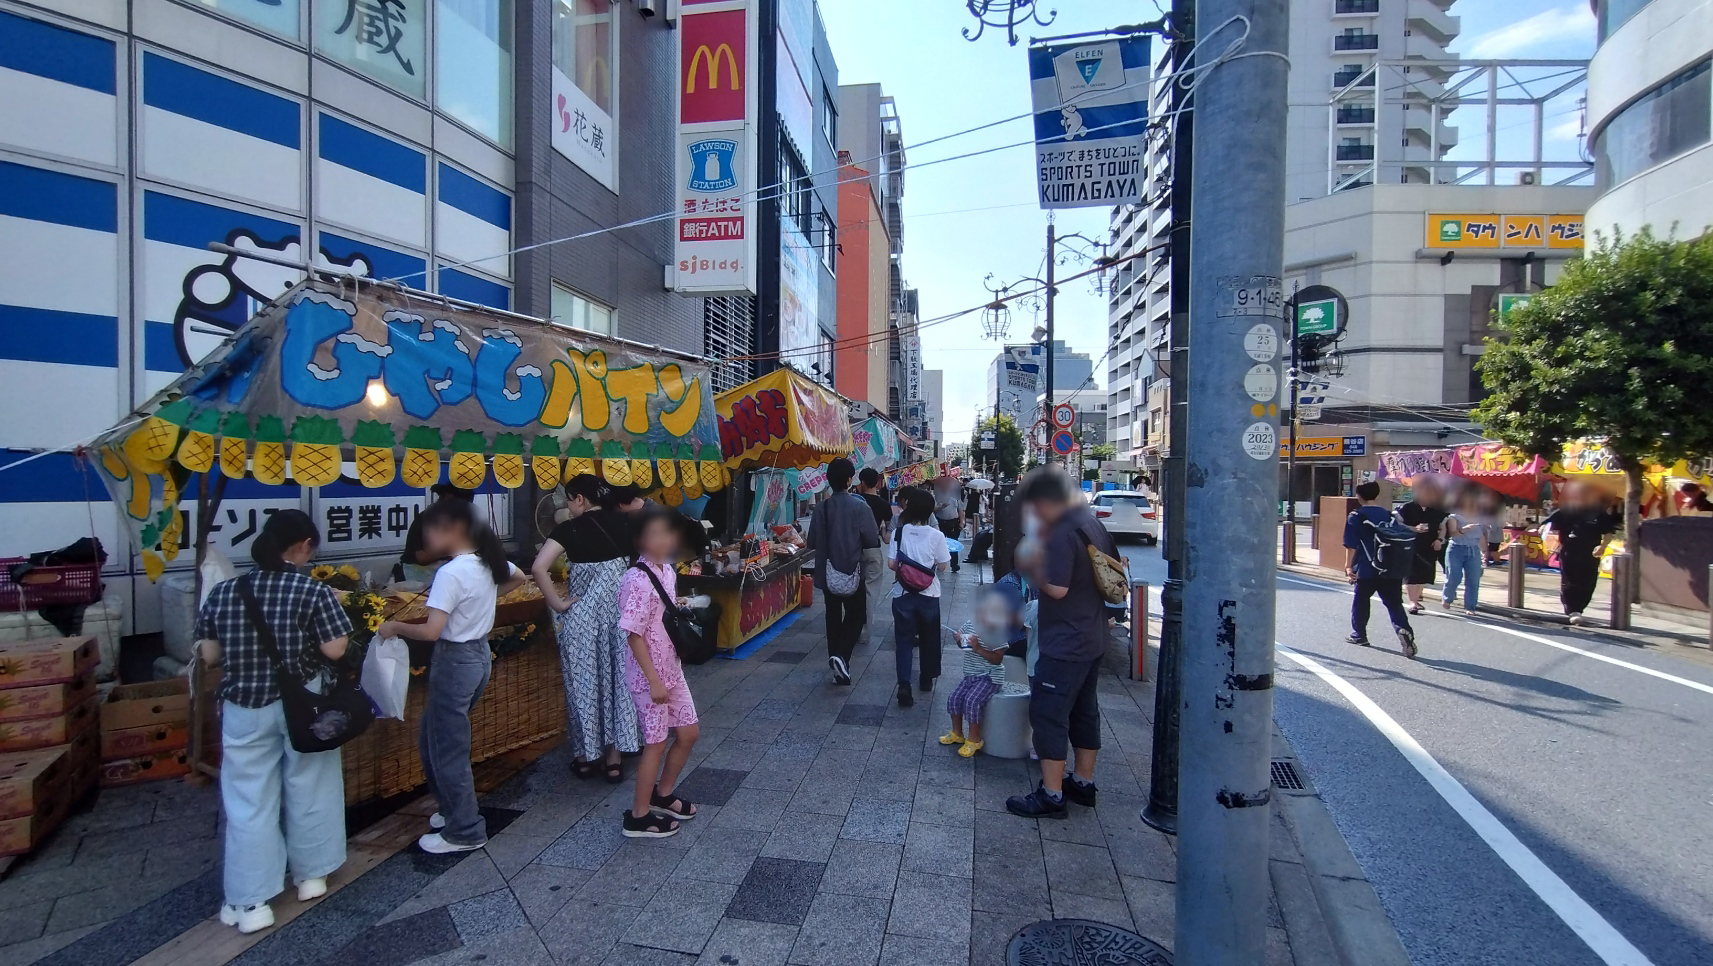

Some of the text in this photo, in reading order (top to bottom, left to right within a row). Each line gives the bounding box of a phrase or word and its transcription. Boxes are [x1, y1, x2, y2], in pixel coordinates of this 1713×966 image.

[1075, 49, 1103, 59] ELFEN
[573, 108, 605, 158] 花蔵
[692, 142, 733, 154] LAWSON
[1040, 146, 1140, 164] スポーツで、まちをひとつに。
[1041, 164, 1093, 181] SPORTS
[692, 179, 733, 190] STATION
[1042, 178, 1137, 202] KUMAGAYA
[683, 221, 741, 238] 銀行ATM
[1466, 222, 1584, 239] タウンハウジ
[1257, 335, 1270, 345] 25
[1057, 410, 1071, 422] 30
[1248, 433, 1273, 444] 2023
